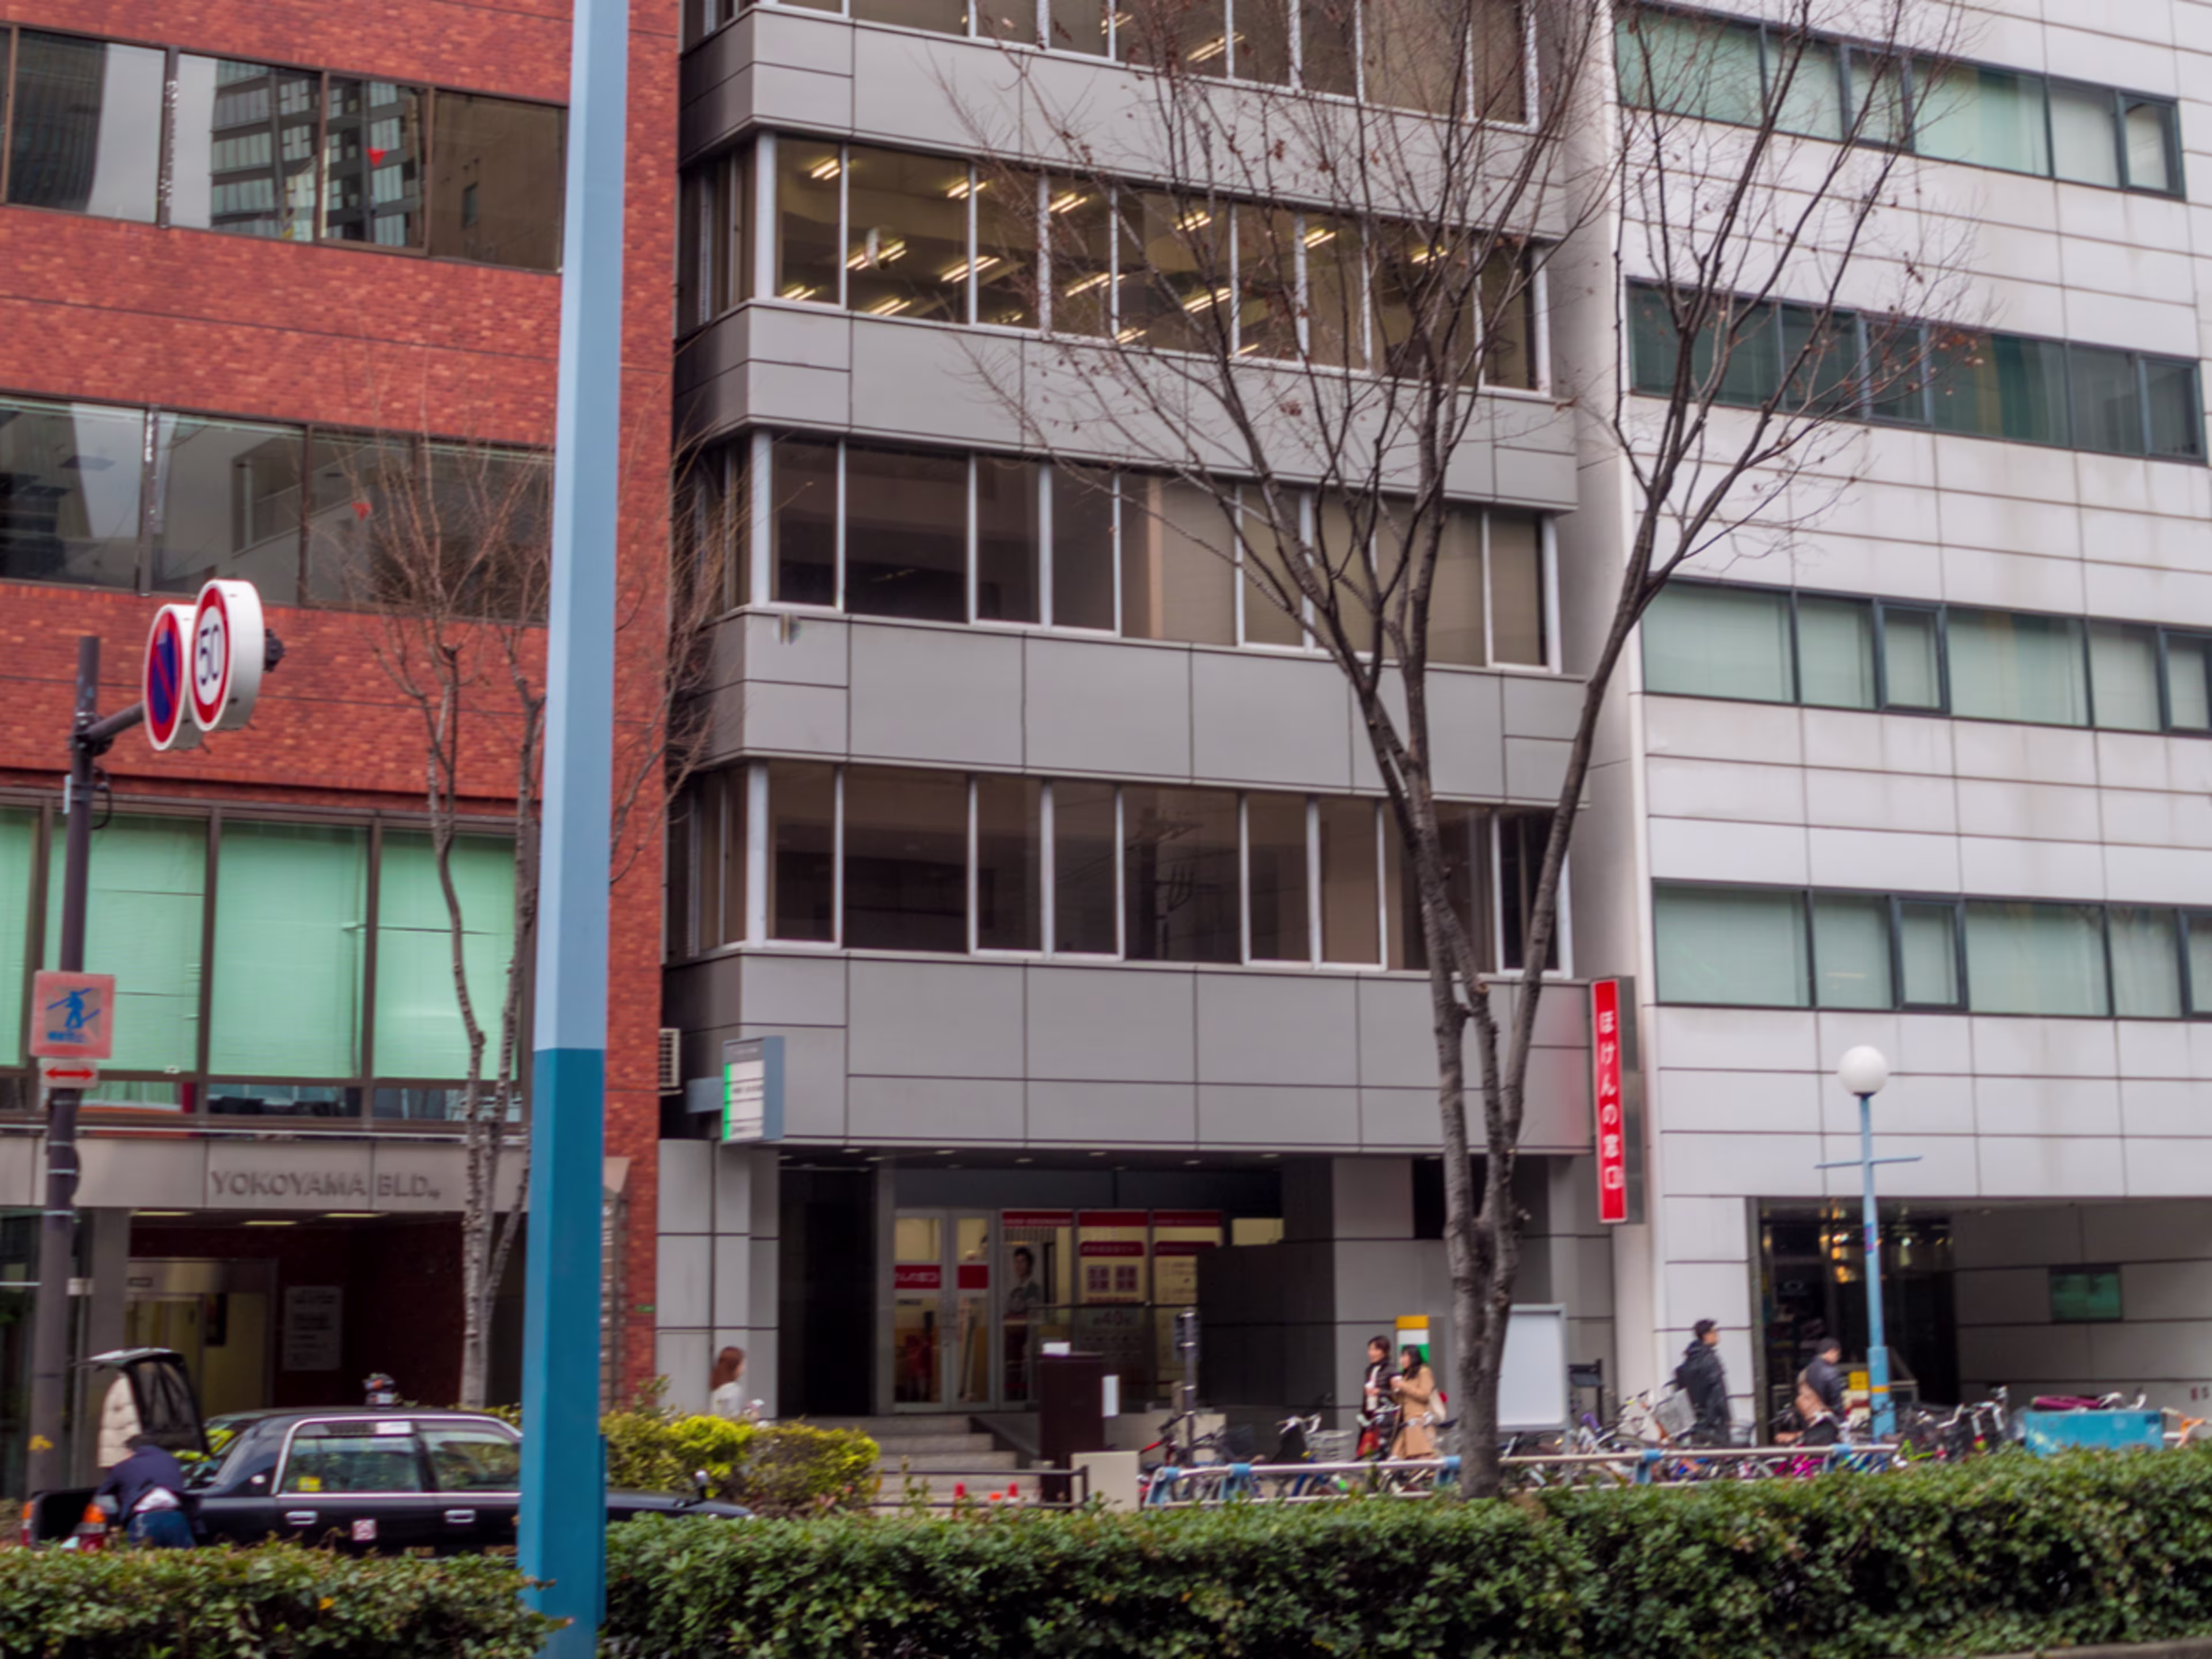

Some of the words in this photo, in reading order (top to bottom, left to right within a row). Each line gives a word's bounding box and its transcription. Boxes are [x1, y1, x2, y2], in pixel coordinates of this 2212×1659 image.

[199, 623, 223, 685] 50
[1599, 1010, 1623, 1190] ほけんの窓口
[211, 1171, 367, 1196] YOKOYAMA
